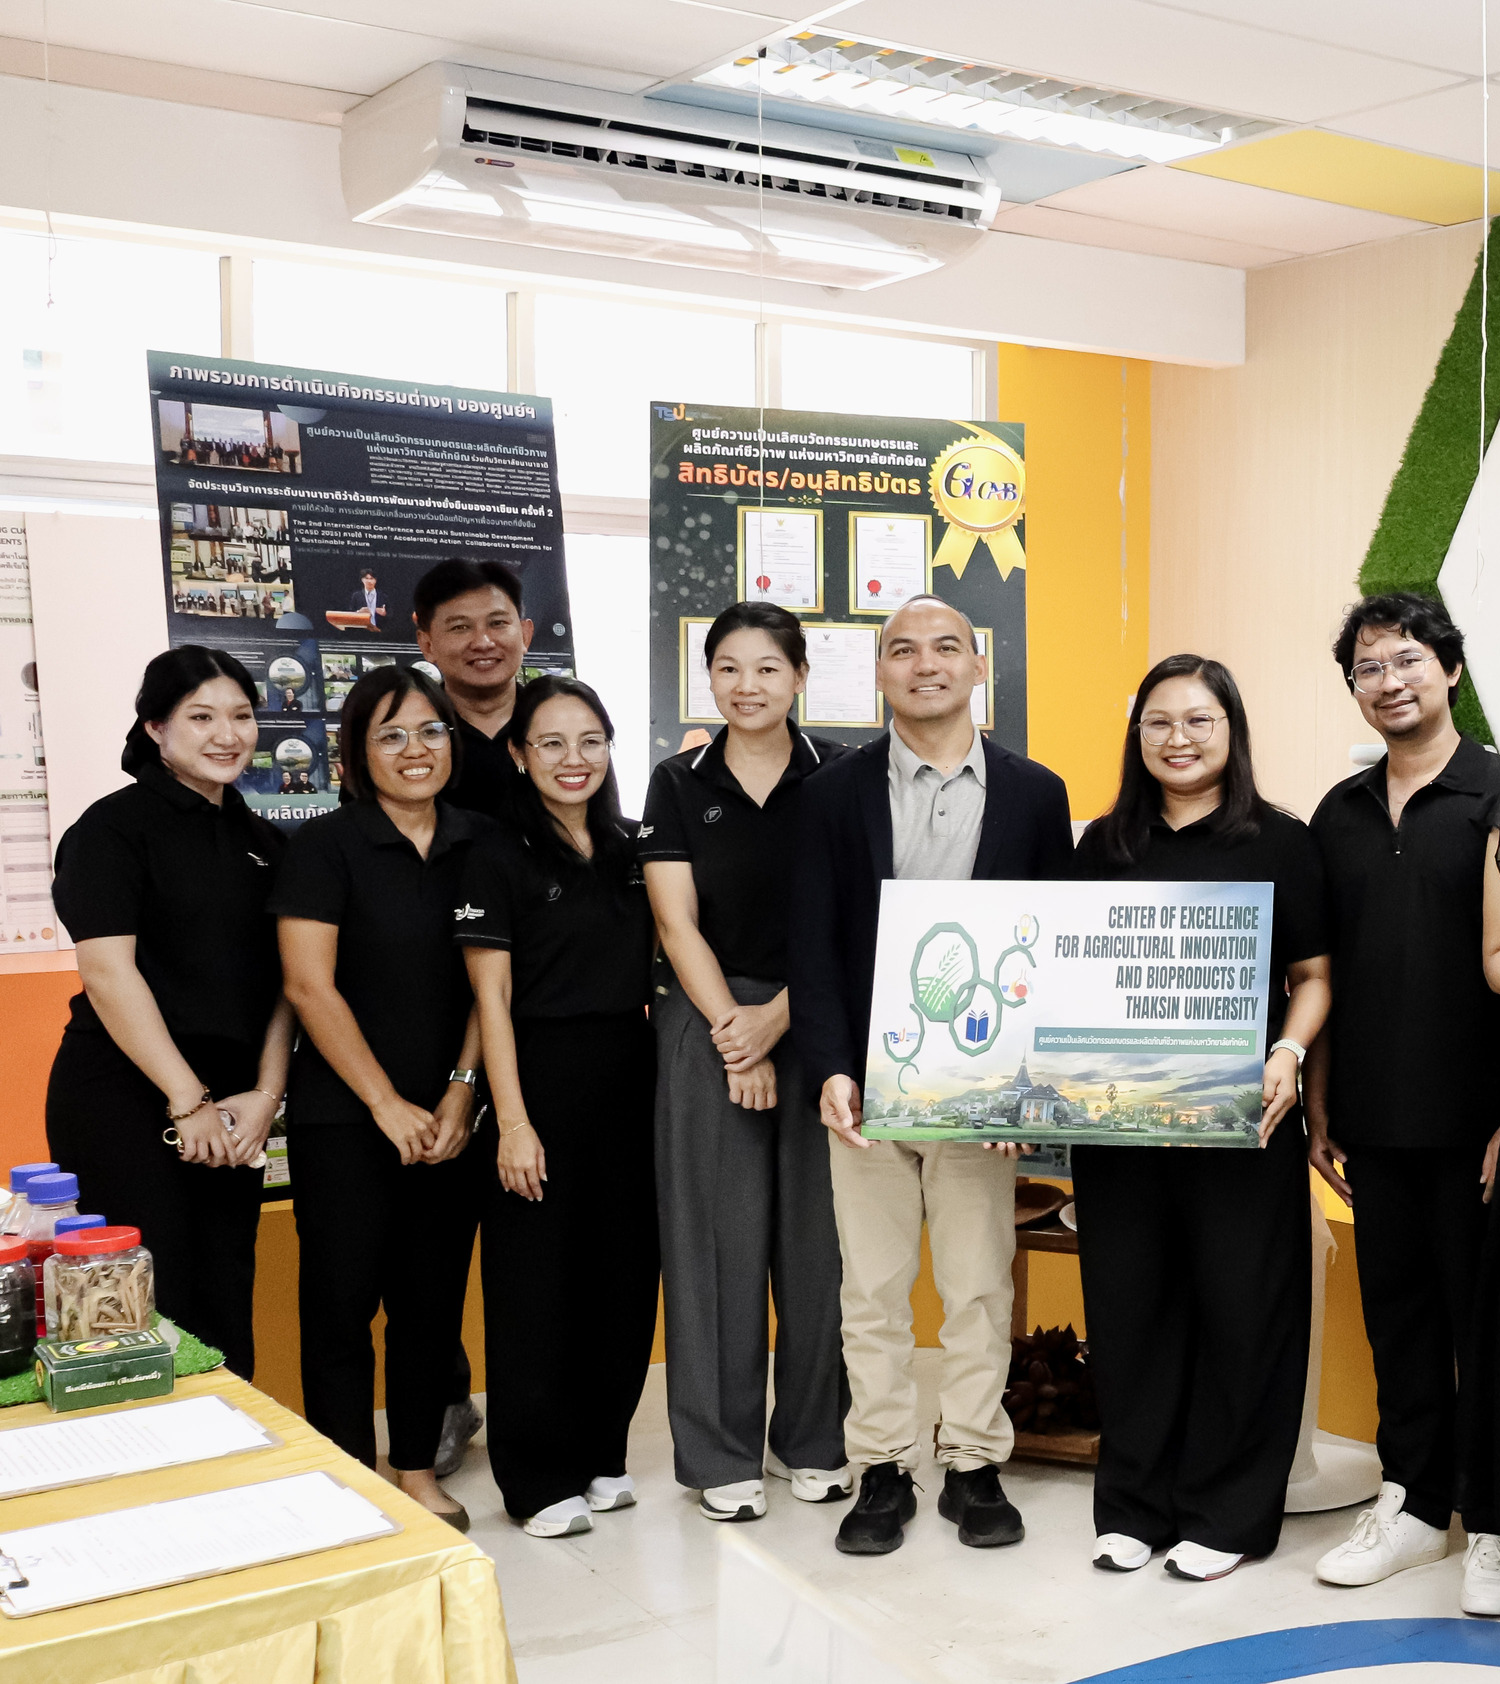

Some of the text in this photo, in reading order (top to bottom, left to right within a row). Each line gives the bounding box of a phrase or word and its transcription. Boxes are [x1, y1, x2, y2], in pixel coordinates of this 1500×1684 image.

[170, 365, 536, 420] ภาพรวมการดำเนินกิจกรรมต่างๆ ของศูนย์ฯ
[692, 427, 919, 451] ศูนย์ความเป็นเลิศนวัตกรรมเกษตรและ
[683, 442, 926, 467] ผลิตภัณฑ์ชีวภาพ แห่งมหาวิทยาลัยทักษิณ
[678, 461, 922, 496] สิทธิบัตร/อนุสิทธิบัตร
[547, 508, 554, 518] 2
[301, 537, 345, 546] Sustainable
[324, 521, 372, 530] International
[373, 525, 414, 534] Conference
[426, 528, 449, 536] ASEAN
[450, 530, 489, 539] Sustainable
[491, 533, 534, 542] Development
[364, 532, 387, 540] Theme
[394, 535, 438, 544] Accelerating
[465, 539, 510, 548] Collaborative
[511, 542, 541, 551] Solutions
[1108, 906, 1259, 930] CENTER OF EXCELLENCE
[1055, 935, 1257, 960] FOR AGRICULTURAL INNOVATION
[1116, 965, 1257, 990] AND BIOPRODUCTS OF
[1126, 996, 1259, 1021] THAKSIN UNIVERSITY
